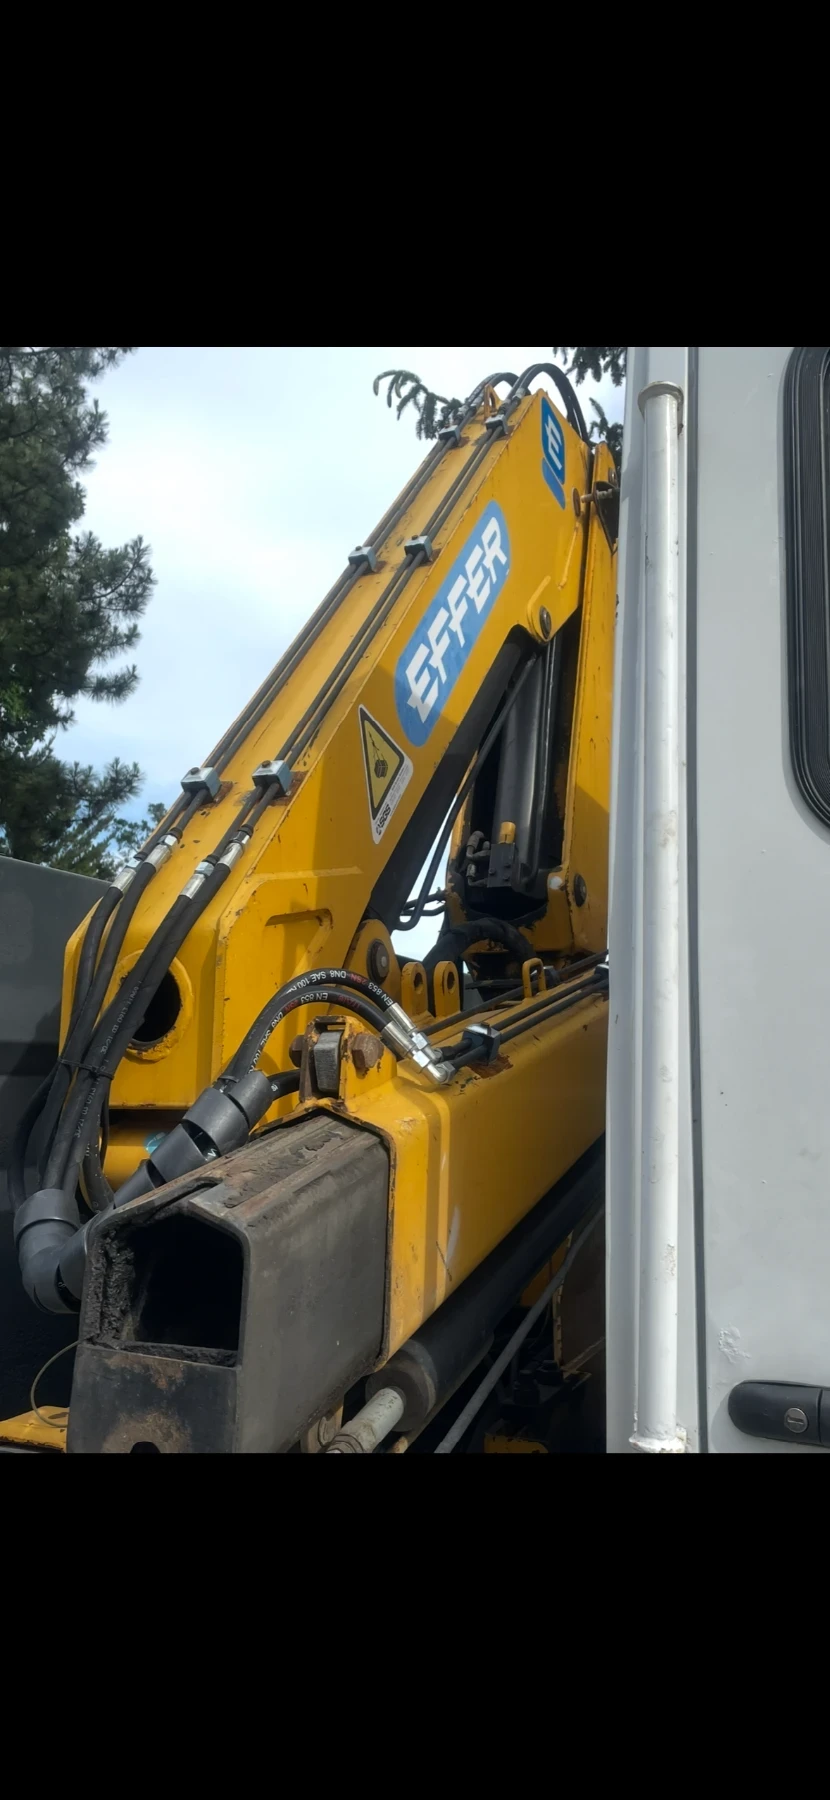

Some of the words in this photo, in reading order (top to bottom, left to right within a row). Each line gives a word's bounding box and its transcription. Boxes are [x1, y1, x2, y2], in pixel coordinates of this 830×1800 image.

[405, 516, 507, 723] EFFER
[310, 971, 327, 982] SAE
[330, 970, 346, 979] DN8
[368, 982, 383, 995] 853
[381, 994, 394, 1006] EN
